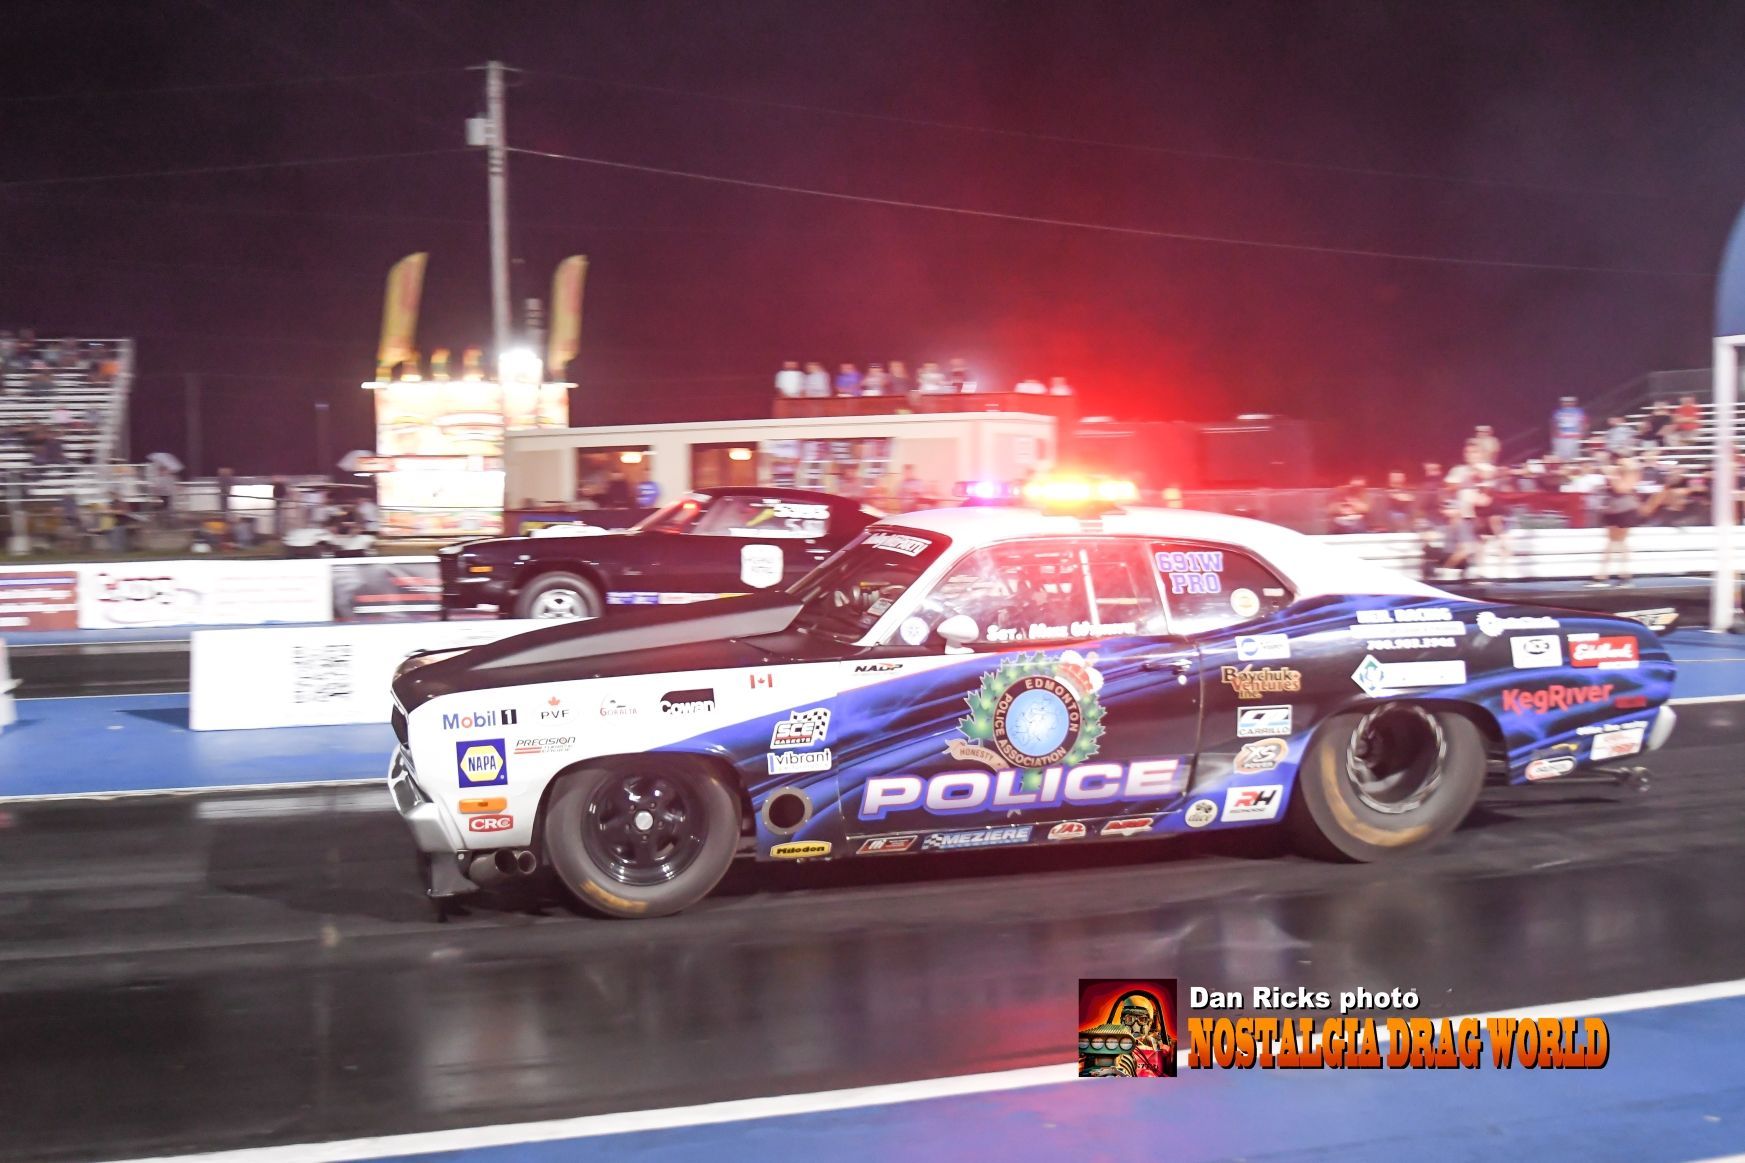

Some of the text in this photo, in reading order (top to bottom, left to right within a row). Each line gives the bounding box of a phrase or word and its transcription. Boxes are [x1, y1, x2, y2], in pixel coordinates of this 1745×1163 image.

[1155, 552, 1223, 572] 691W
[1169, 572, 1222, 594] PRO
[660, 700, 715, 717] Cowan
[1024, 678, 1081, 732] EDMONTON
[442, 710, 497, 730] Mobil
[540, 709, 571, 720] PVF
[777, 722, 815, 737] SCE
[994, 693, 1067, 767] POLICE ASSOCIATION
[1239, 726, 1290, 736] CARRILLO
[959, 748, 994, 762] HONESTY
[1247, 744, 1279, 762] XS
[468, 755, 497, 772] NAPA
[861, 757, 1182, 818] POLICE
[1235, 789, 1277, 807] RH
[470, 817, 512, 830] CRC
[941, 827, 1030, 845] MEZIERE
